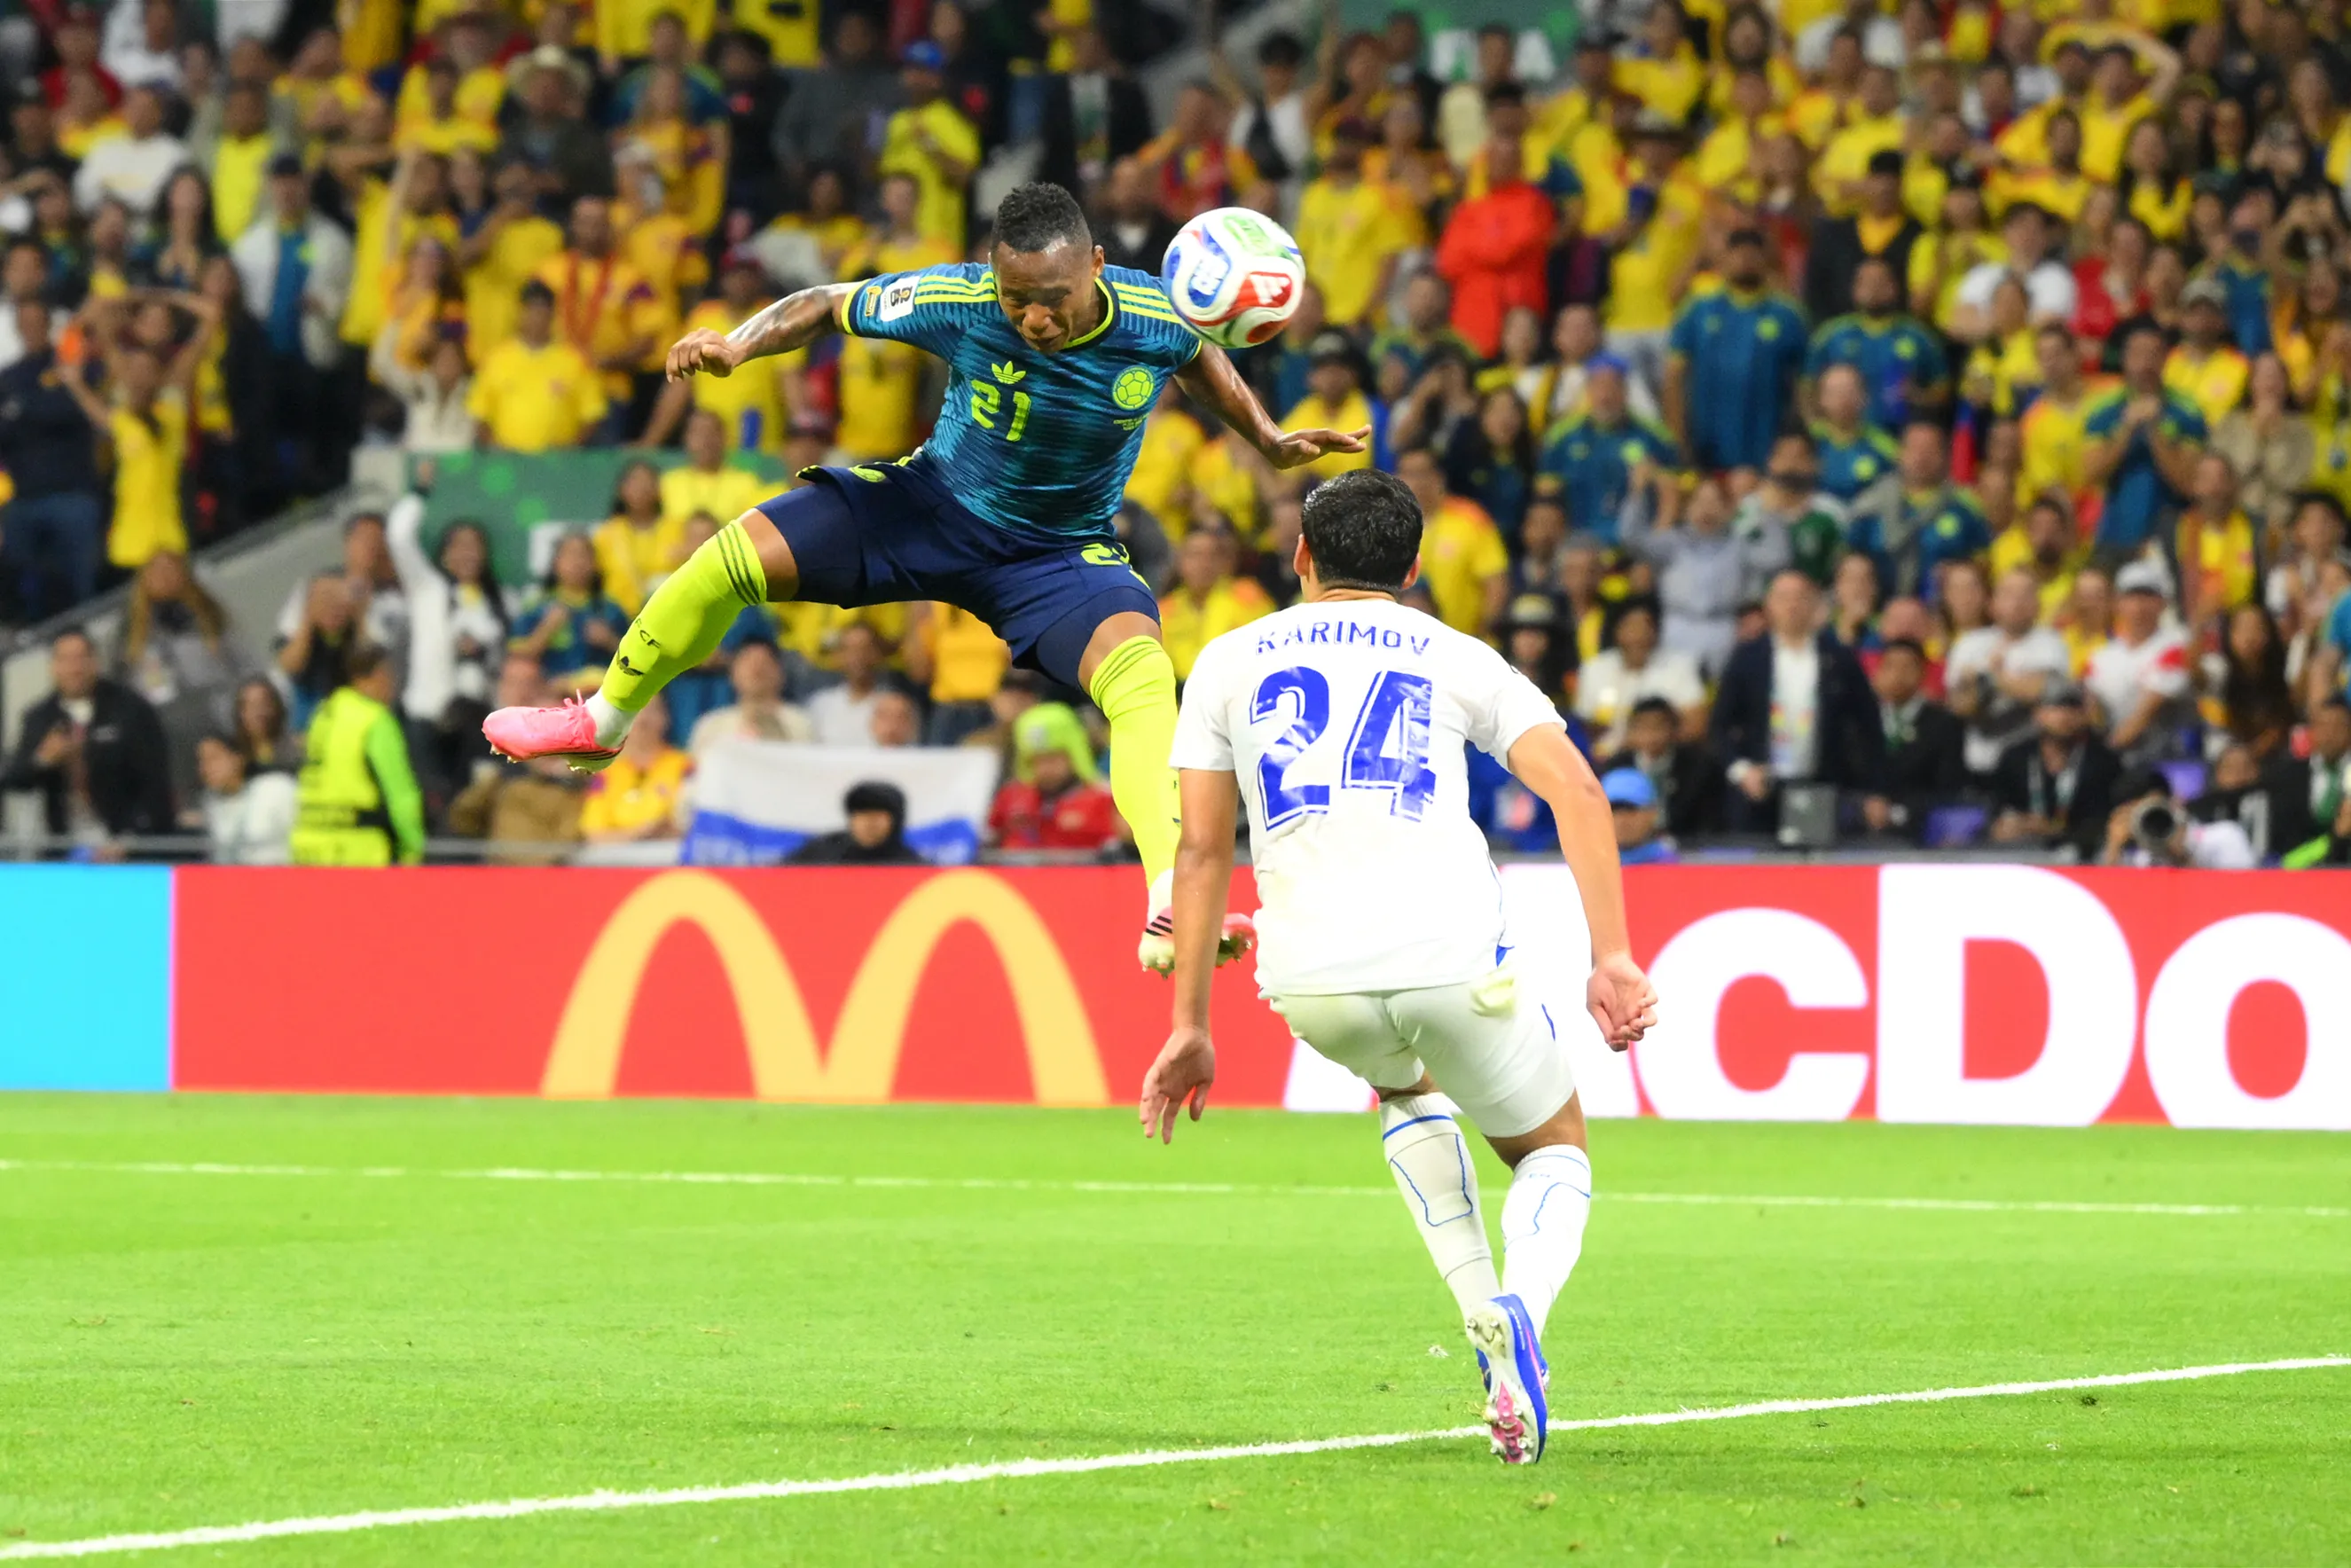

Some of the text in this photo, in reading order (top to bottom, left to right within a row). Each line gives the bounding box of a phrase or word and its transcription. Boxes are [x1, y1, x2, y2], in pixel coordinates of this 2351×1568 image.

[970, 380, 1031, 442] 21
[1256, 621, 1430, 656] KARIMOV
[1250, 665, 1437, 832] 24
